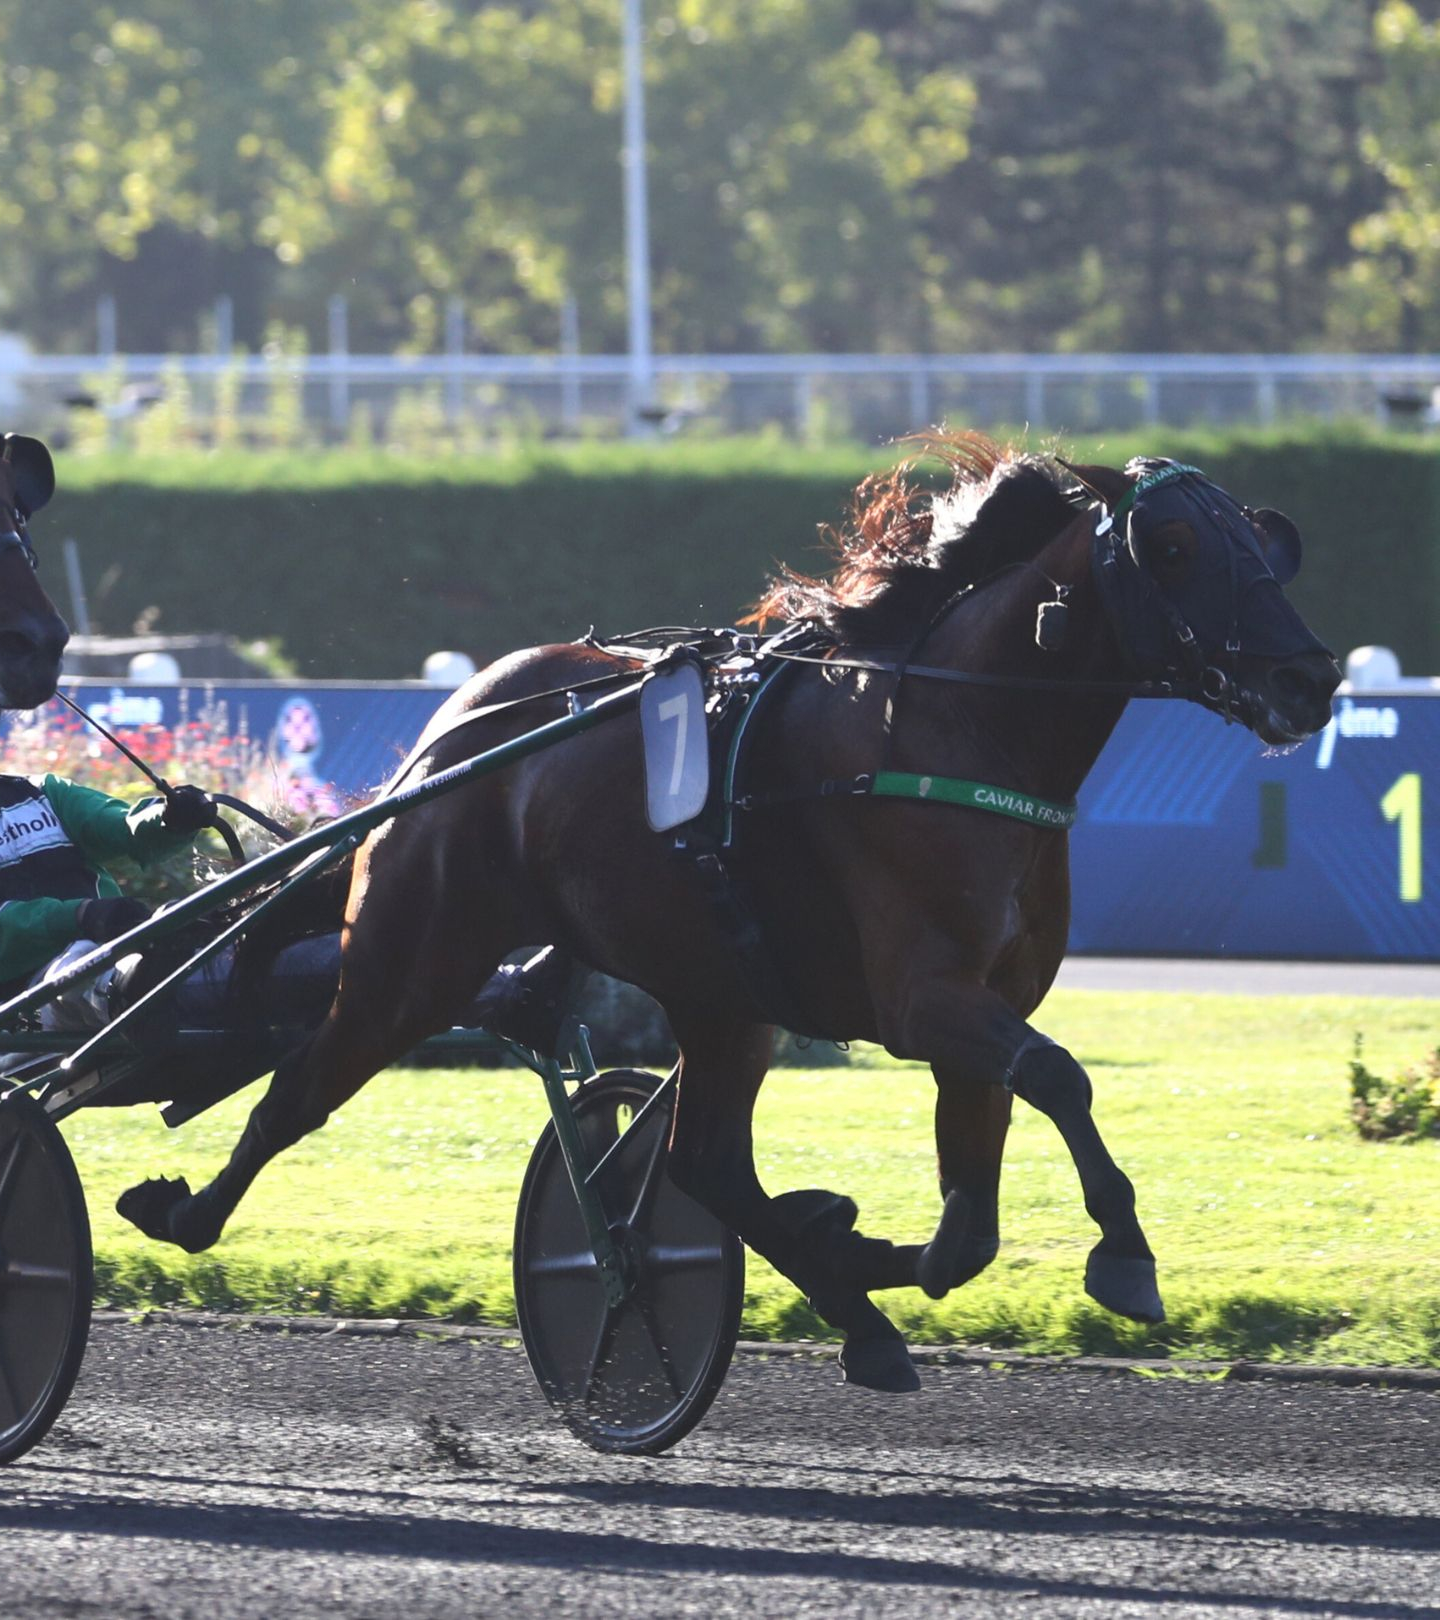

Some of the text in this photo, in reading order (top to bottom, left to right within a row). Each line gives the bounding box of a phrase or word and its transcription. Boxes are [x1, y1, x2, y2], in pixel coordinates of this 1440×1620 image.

[658, 693, 689, 796] 7
[974, 789, 1034, 817] CAVIAR
[1380, 773, 1423, 902] 1
